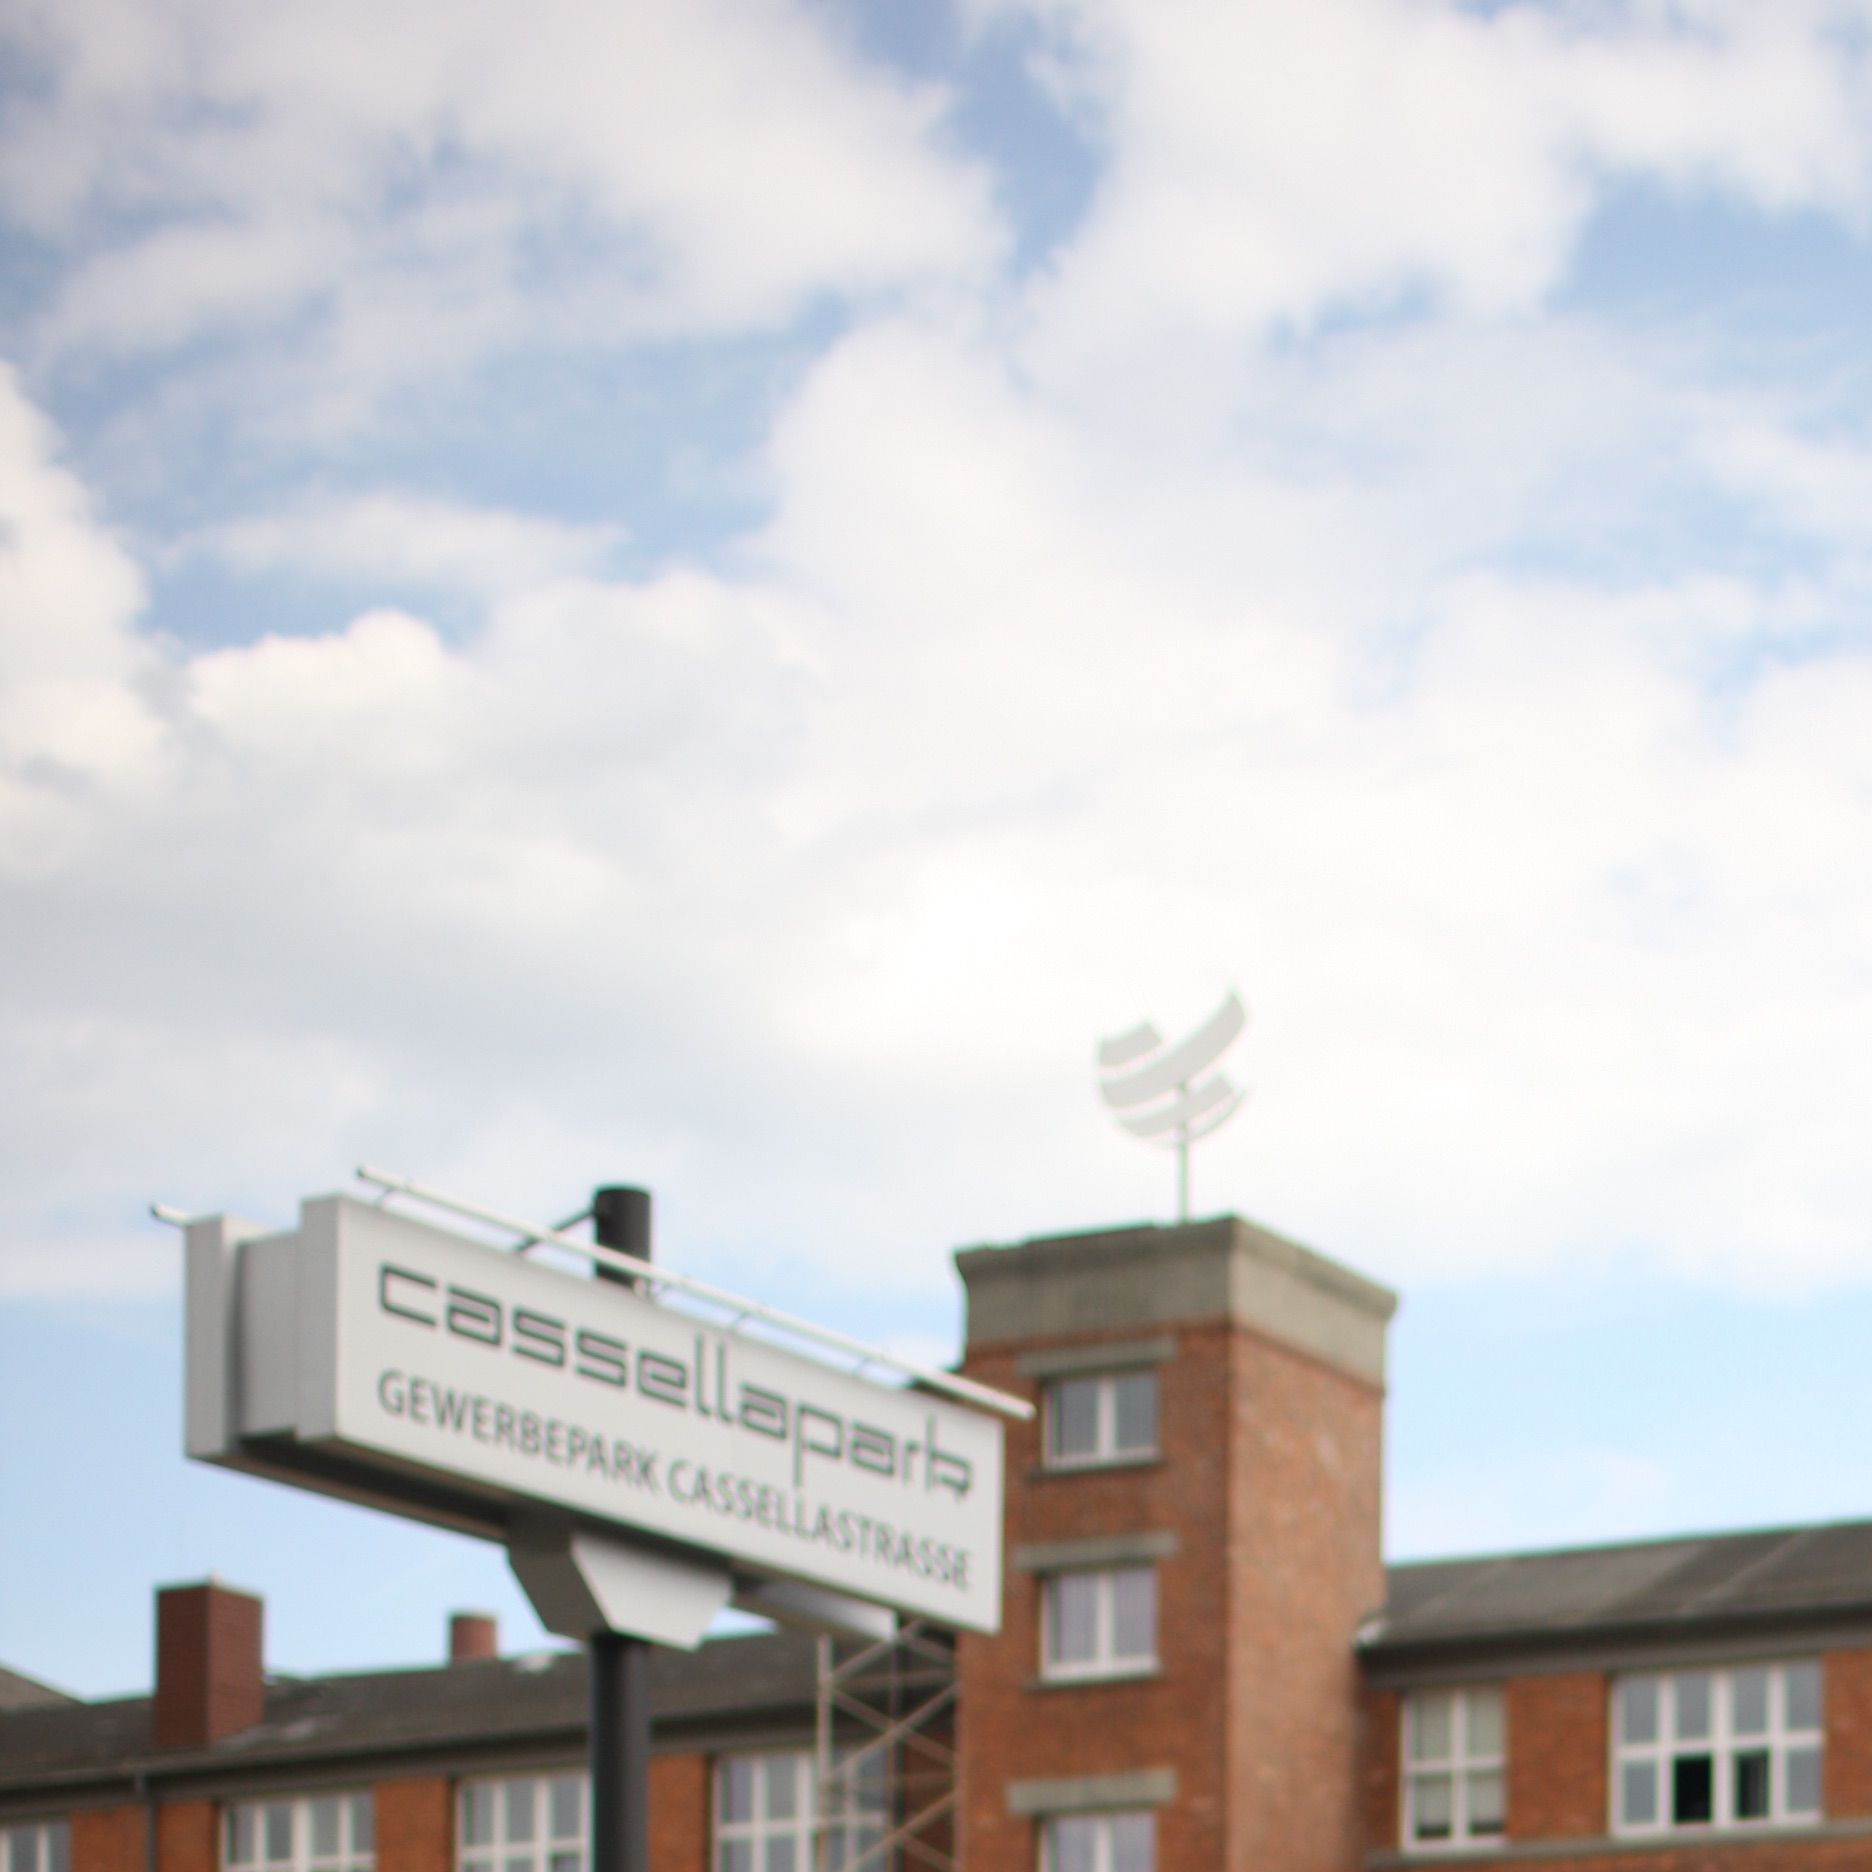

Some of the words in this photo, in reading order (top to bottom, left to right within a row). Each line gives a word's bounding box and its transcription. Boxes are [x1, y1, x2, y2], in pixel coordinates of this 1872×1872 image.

[378, 1368, 658, 1491] GEWERBEPARK
[667, 1458, 970, 1590] CASSELLASTRASSE
[380, 1263, 972, 1503] cassellapark
